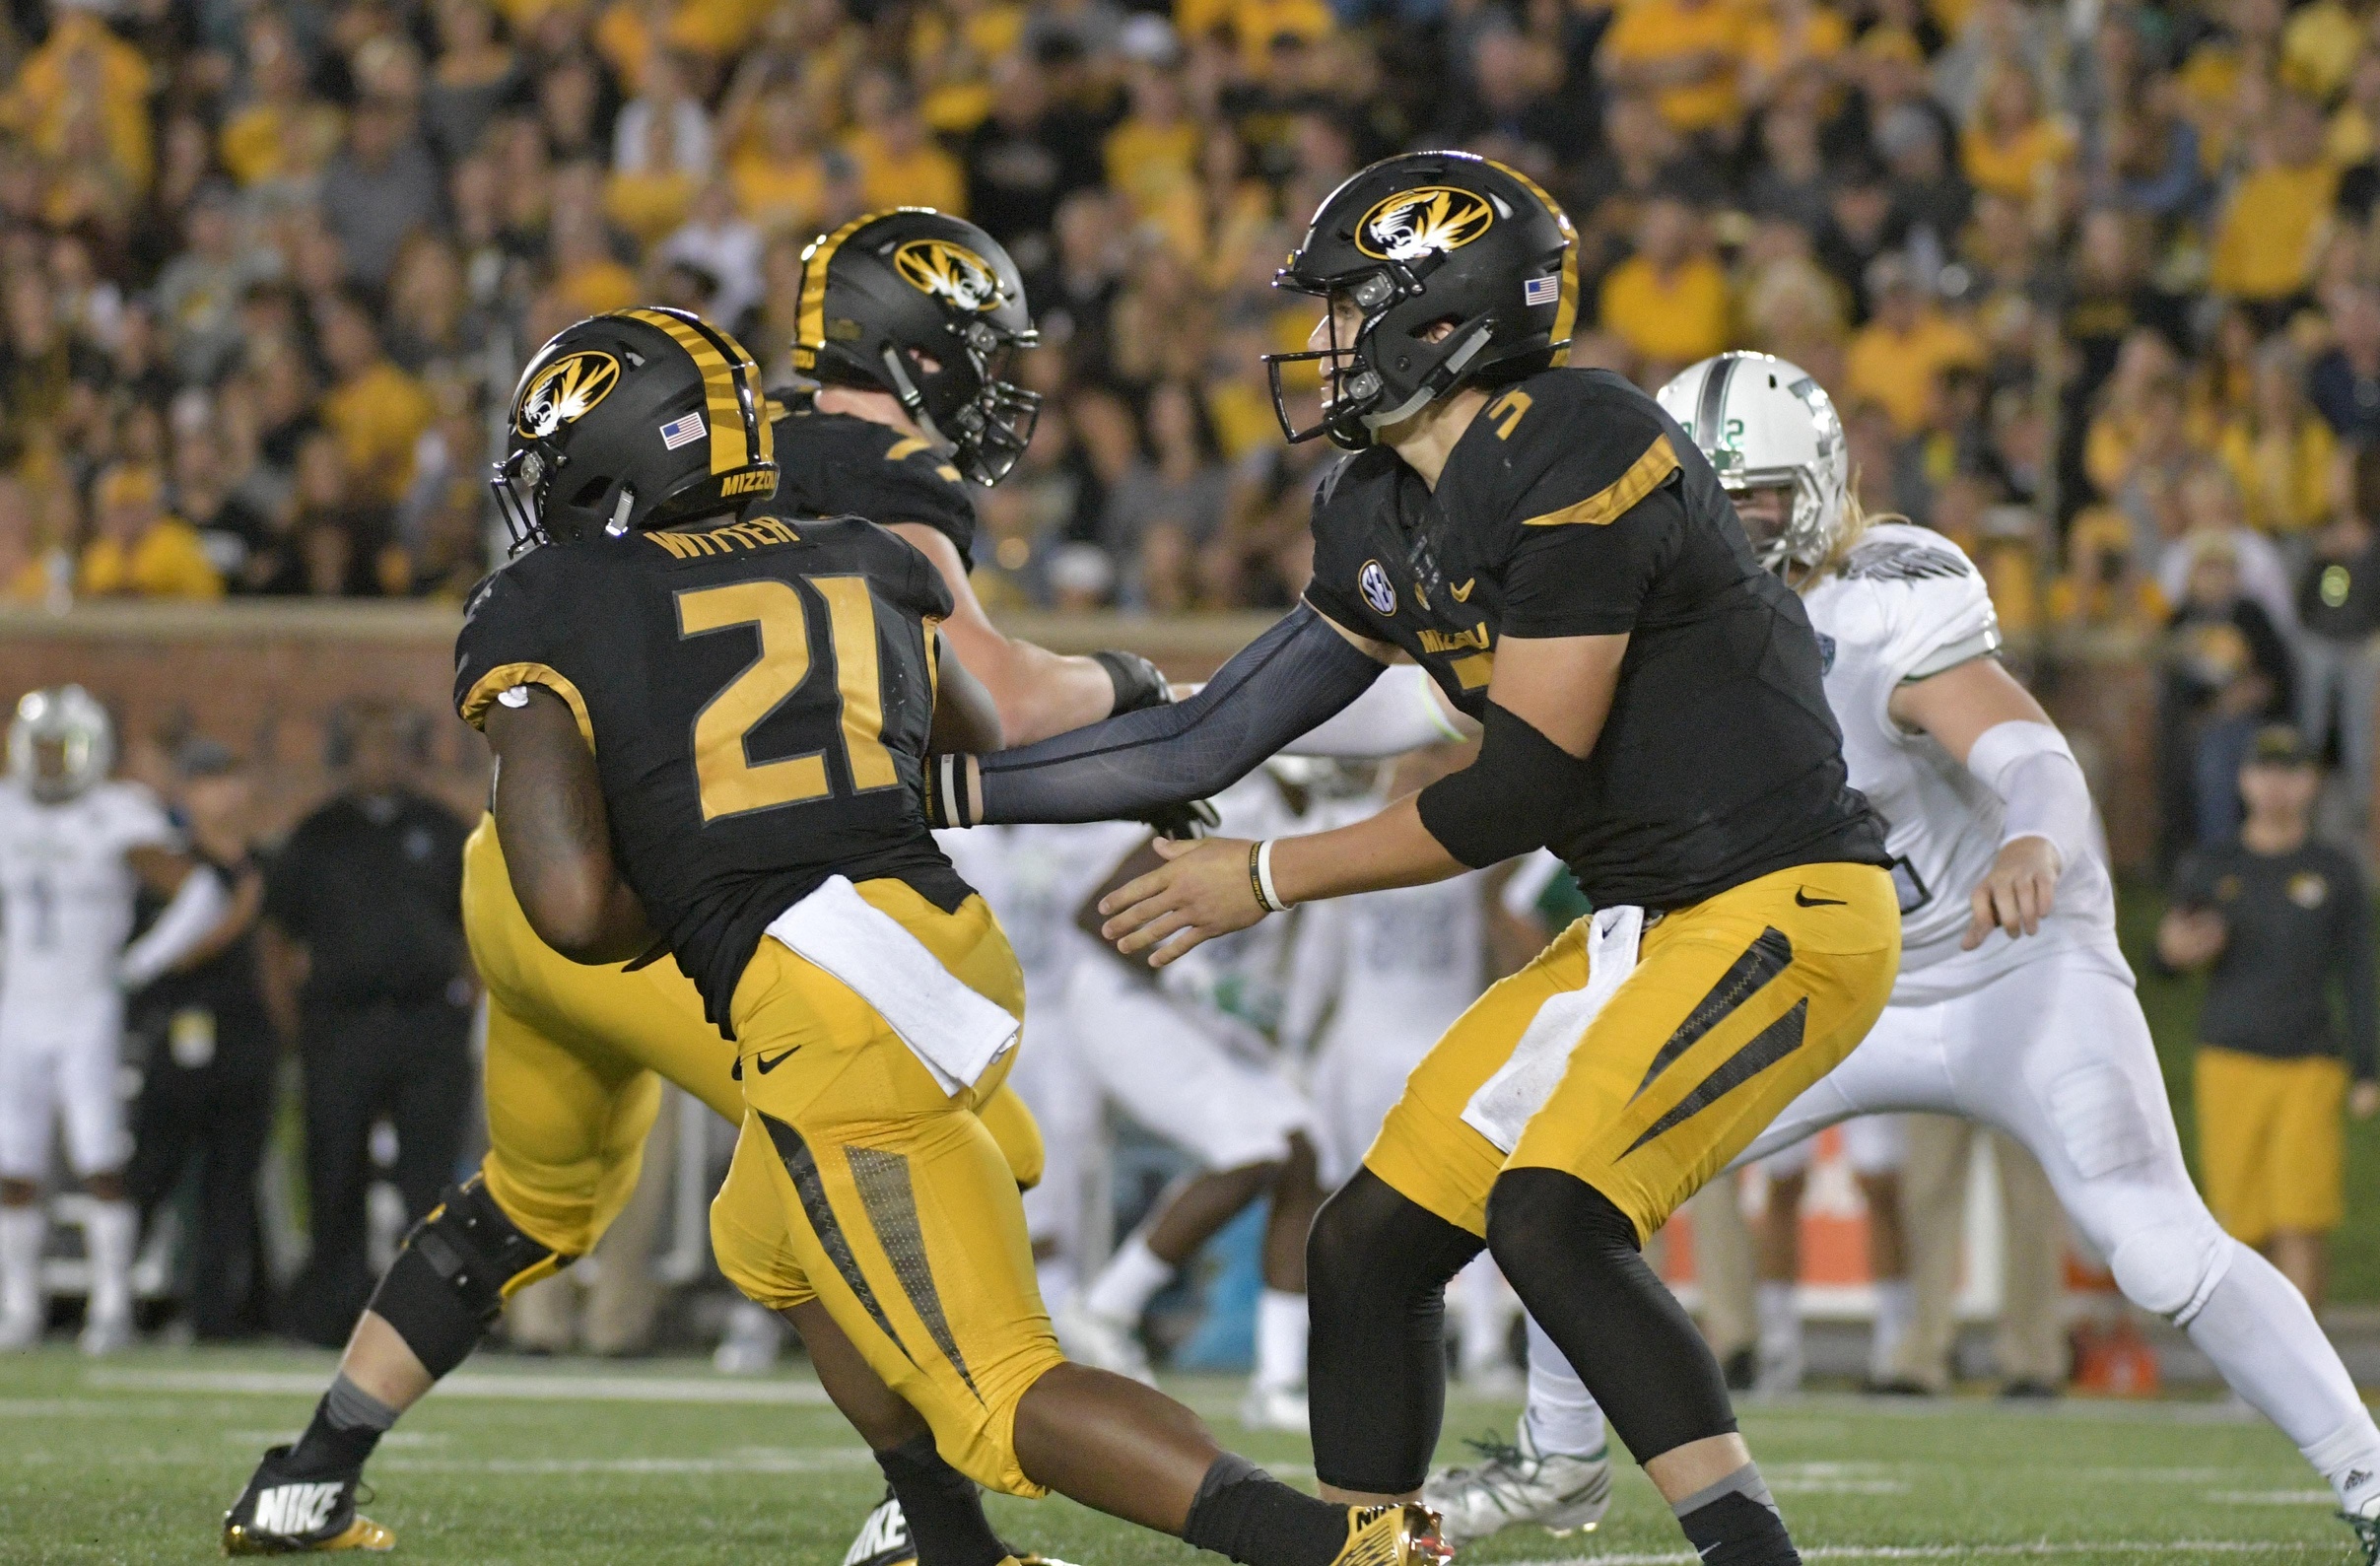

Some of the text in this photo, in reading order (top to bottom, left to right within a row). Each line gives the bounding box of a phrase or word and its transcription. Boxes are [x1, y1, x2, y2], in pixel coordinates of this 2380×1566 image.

[1727, 419, 1744, 449] 2
[643, 516, 800, 559] WITTER
[1361, 563, 1394, 612] SEC
[674, 575, 905, 827] 21
[255, 1481, 344, 1534] NIKE
